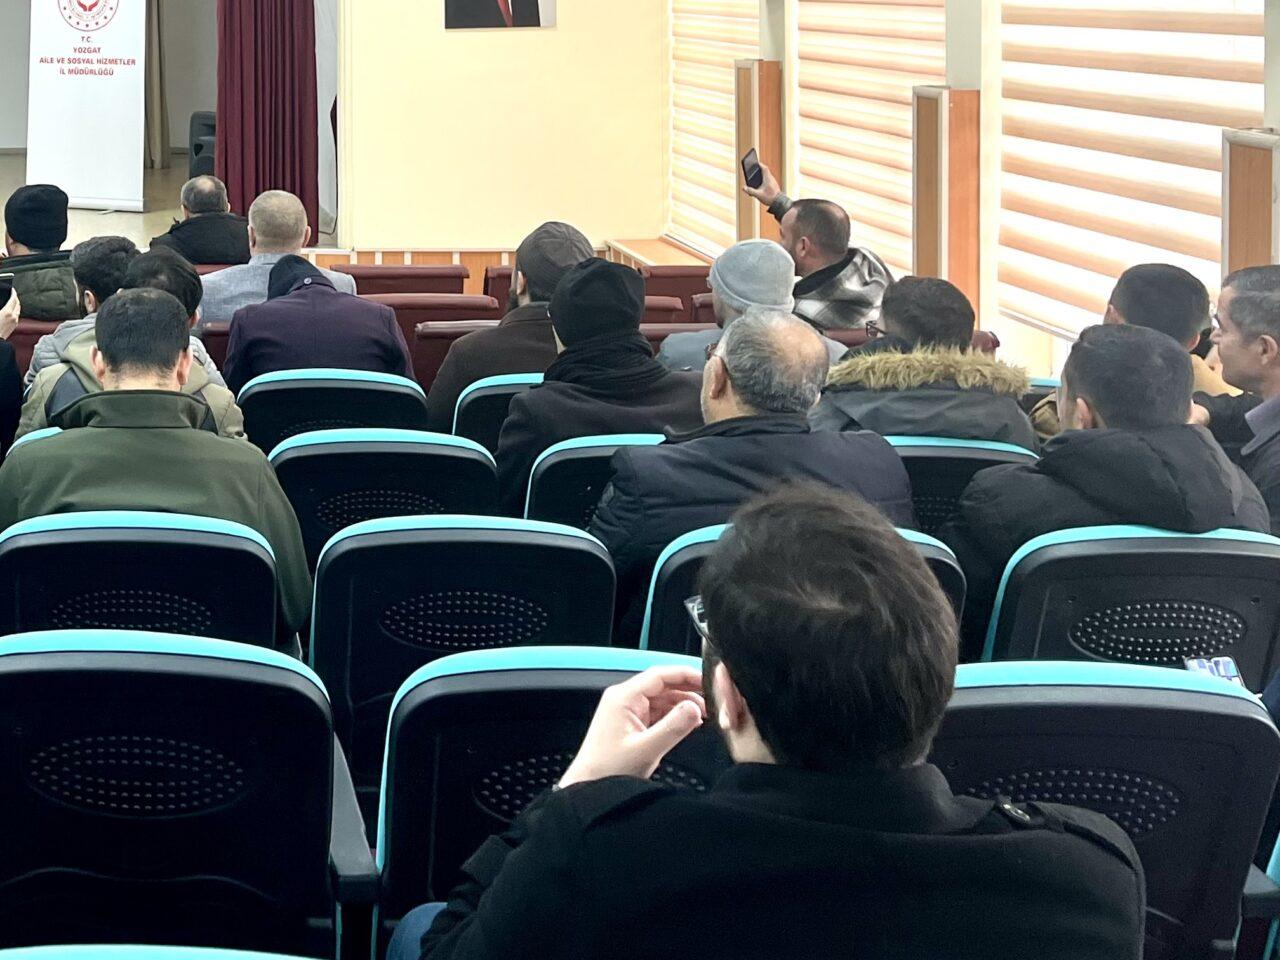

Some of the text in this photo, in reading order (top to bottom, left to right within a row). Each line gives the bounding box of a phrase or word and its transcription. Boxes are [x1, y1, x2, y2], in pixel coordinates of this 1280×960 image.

[39, 56, 136, 66] AİLE VE SOSYAL HİZMETLER
[68, 67, 114, 77] MÜDÜRLÜĞÜ
